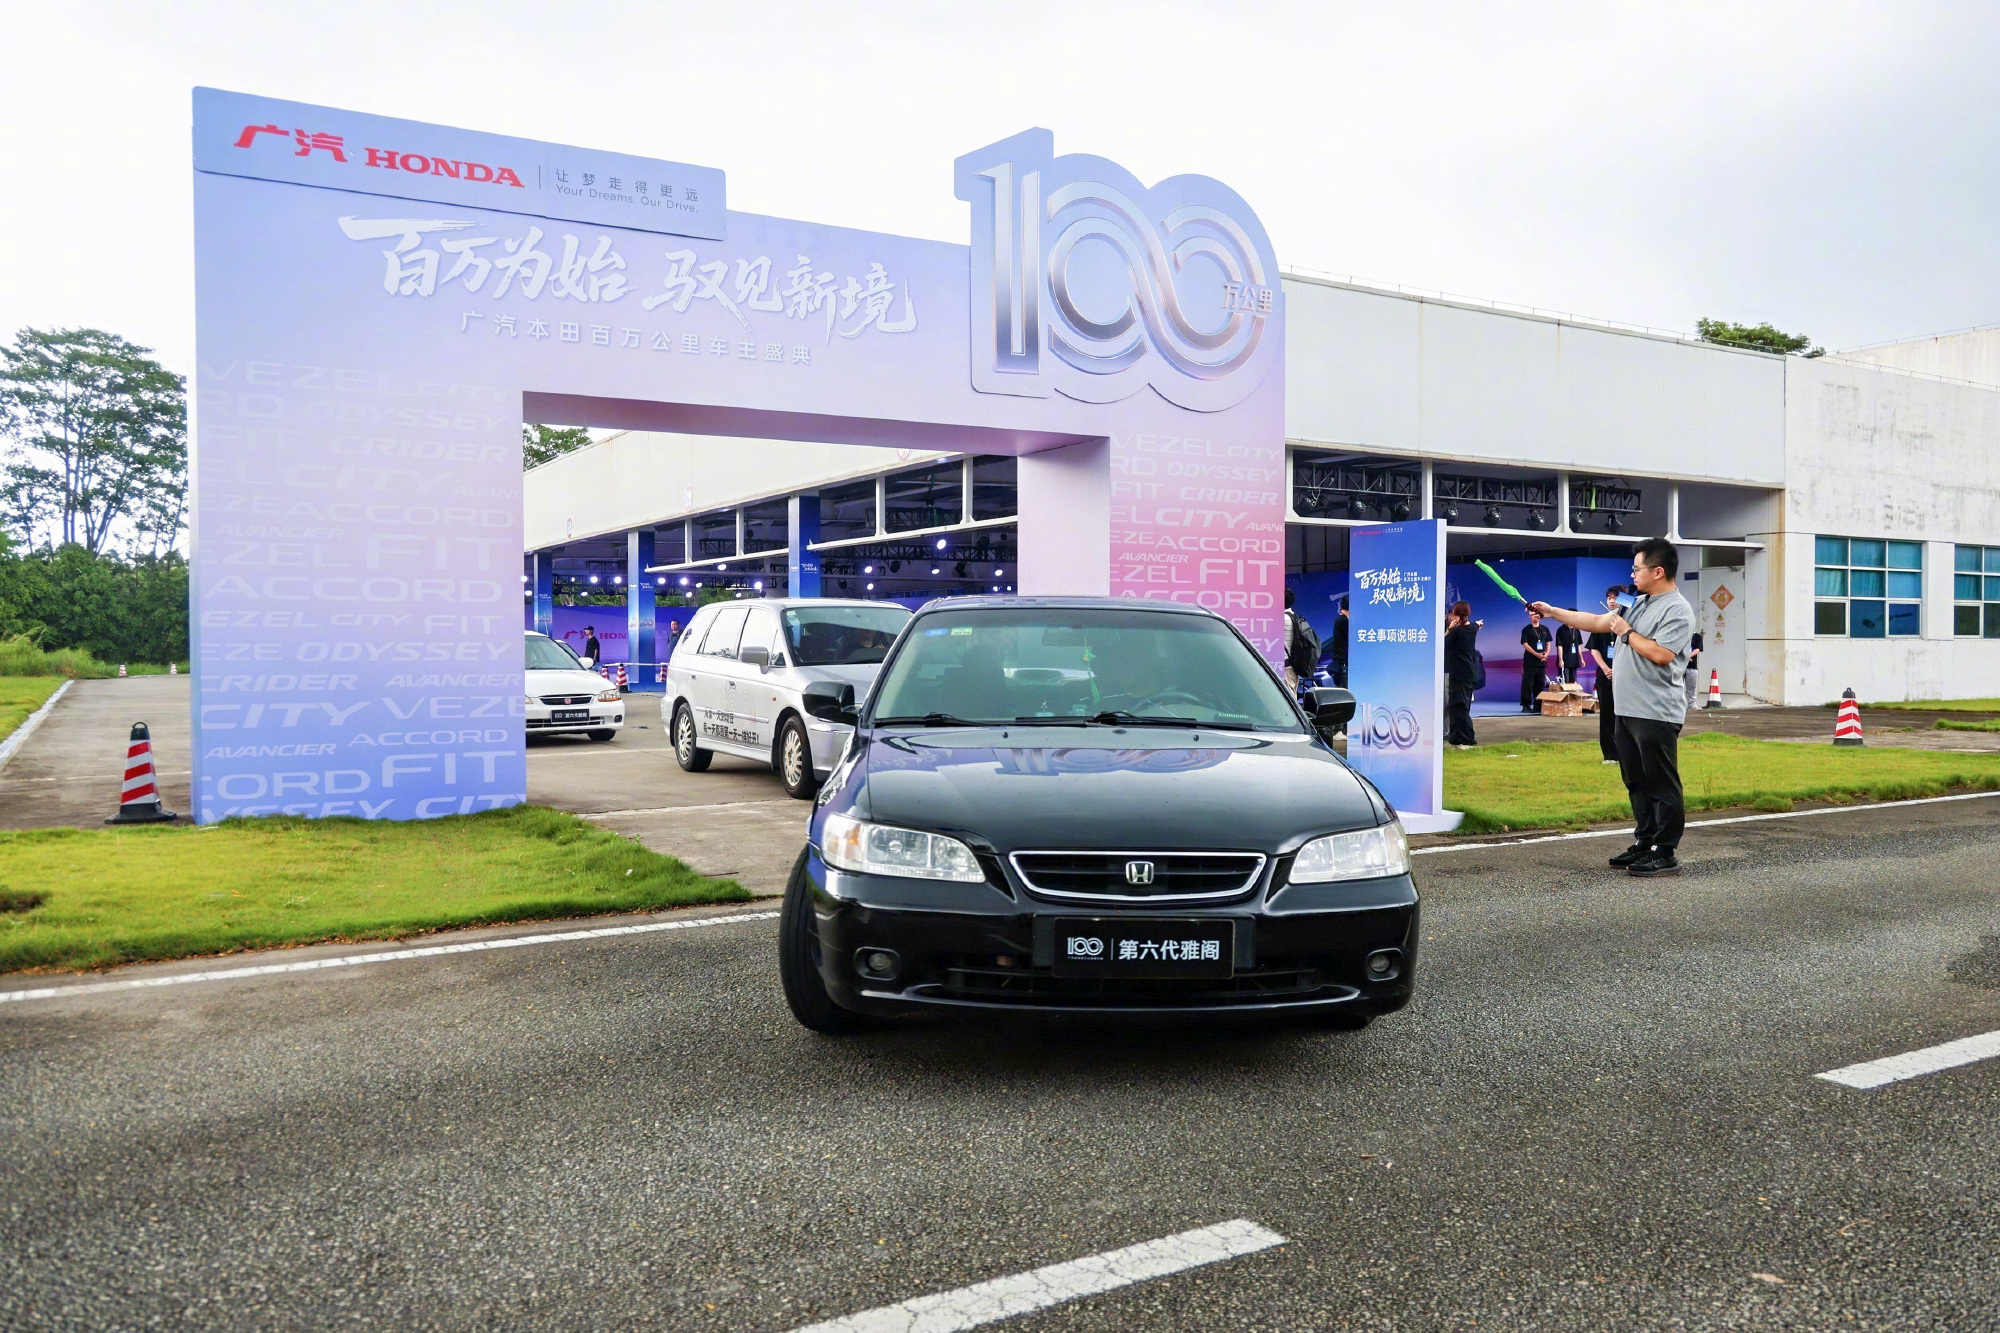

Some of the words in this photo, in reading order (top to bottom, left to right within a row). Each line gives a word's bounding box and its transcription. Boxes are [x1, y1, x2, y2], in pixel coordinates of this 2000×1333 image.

[234, 124, 348, 162] 广汽
[364, 146, 526, 188] HONDA
[555, 169, 698, 202] 让梦走得更远
[556, 184, 583, 196] Your
[589, 188, 636, 204] Dreams.
[640, 196, 661, 207] Our
[666, 200, 698, 213] Drive.
[338, 214, 640, 304] 百万为始
[641, 249, 917, 348] 驭见新境
[971, 161, 1266, 381] 100
[1222, 283, 1273, 314] 万公里
[460, 310, 811, 365] 广汽本田百万公里车主盛典
[330, 435, 510, 463] CRIDER
[1109, 430, 1229, 458] VEZEL
[1227, 445, 1284, 460] CITY
[284, 463, 456, 494] CITY
[1167, 461, 1278, 483] ODYSSEY
[1111, 480, 1165, 500] FIT
[1179, 486, 1278, 506] CRIDER
[282, 501, 515, 529] ACCORD
[1155, 507, 1249, 529] CITY
[214, 524, 345, 540] AVANCIER
[1154, 535, 1281, 554] ACCORD
[366, 533, 513, 572] FIT
[1118, 552, 1189, 563] AVANCIER
[1201, 558, 1280, 586] FIT
[1355, 567, 1402, 590] 百万为始
[205, 574, 502, 603] ACCORD
[1369, 582, 1425, 609] 驭见新境
[330, 613, 412, 626] CITY
[424, 614, 502, 634] FIT
[1357, 628, 1428, 643] 安全事项说明会
[296, 641, 513, 663] ODYSSEY
[385, 673, 522, 688] AVANCIER
[200, 700, 374, 730] CITY
[1360, 702, 1420, 750] 100
[204, 743, 336, 760] AVANCIER
[347, 729, 508, 748] ACCORD
[201, 768, 371, 801] ORD
[381, 750, 517, 788] FIT
[415, 793, 527, 821] CIT
[1067, 937, 1105, 956] 100
[1118, 939, 1220, 961] 第六代雅阁
